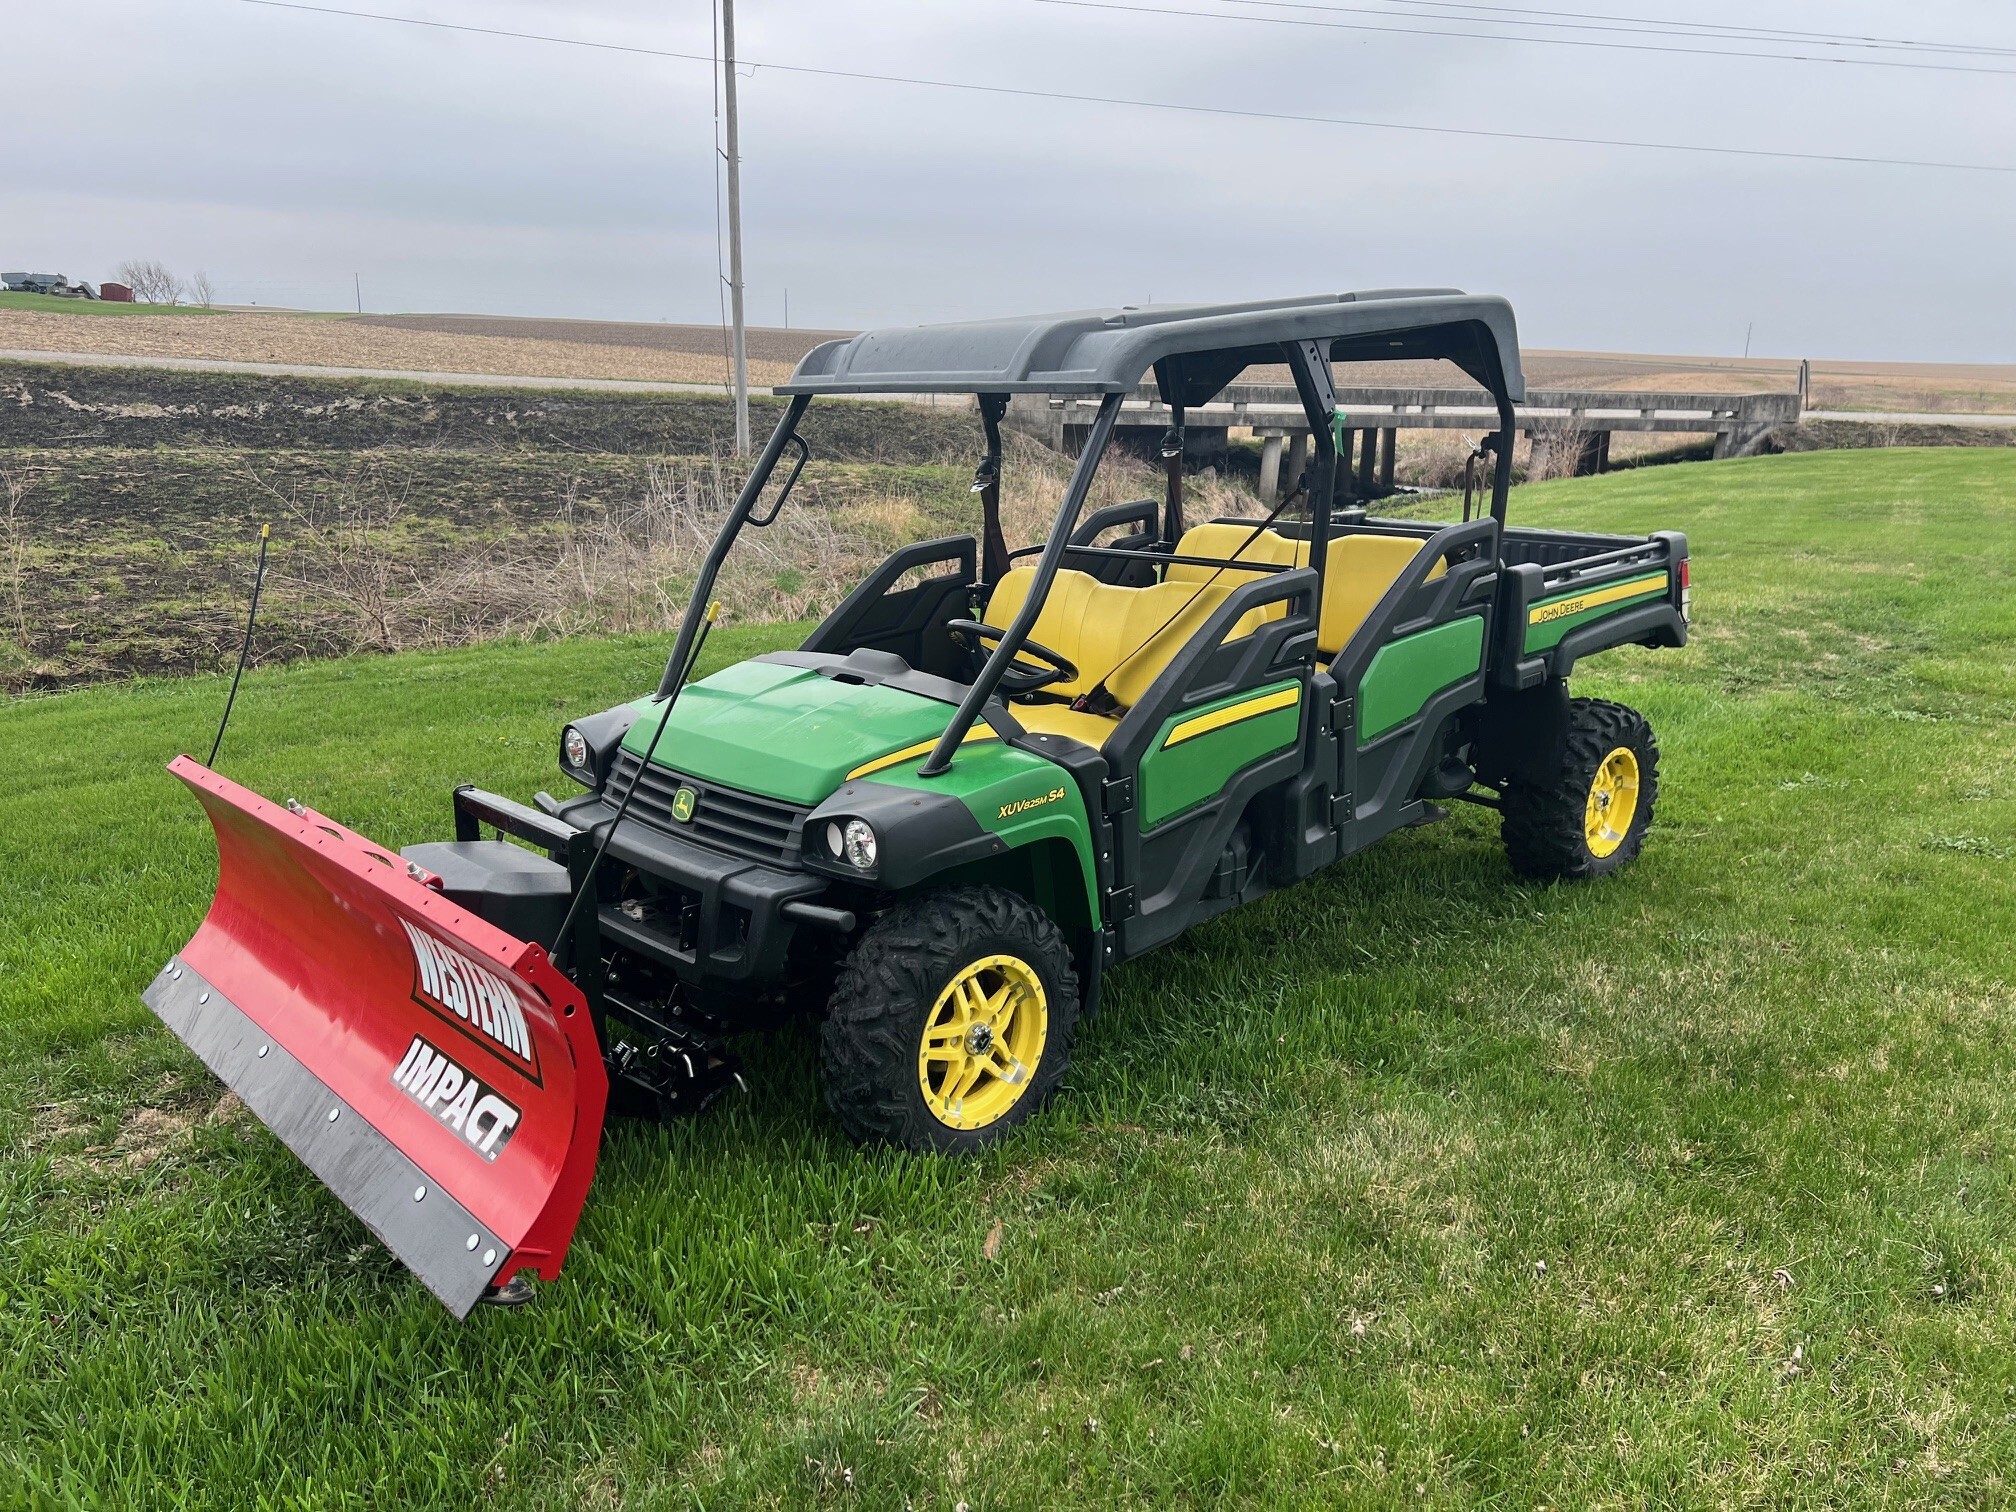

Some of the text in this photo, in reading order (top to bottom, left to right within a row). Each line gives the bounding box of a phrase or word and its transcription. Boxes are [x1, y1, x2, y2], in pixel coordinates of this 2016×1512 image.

[1538, 601, 1584, 621] JOHN DEERE
[1048, 786, 1065, 802] S4
[397, 915, 533, 1064] WESTERN
[392, 1037, 520, 1153] IMPACT
